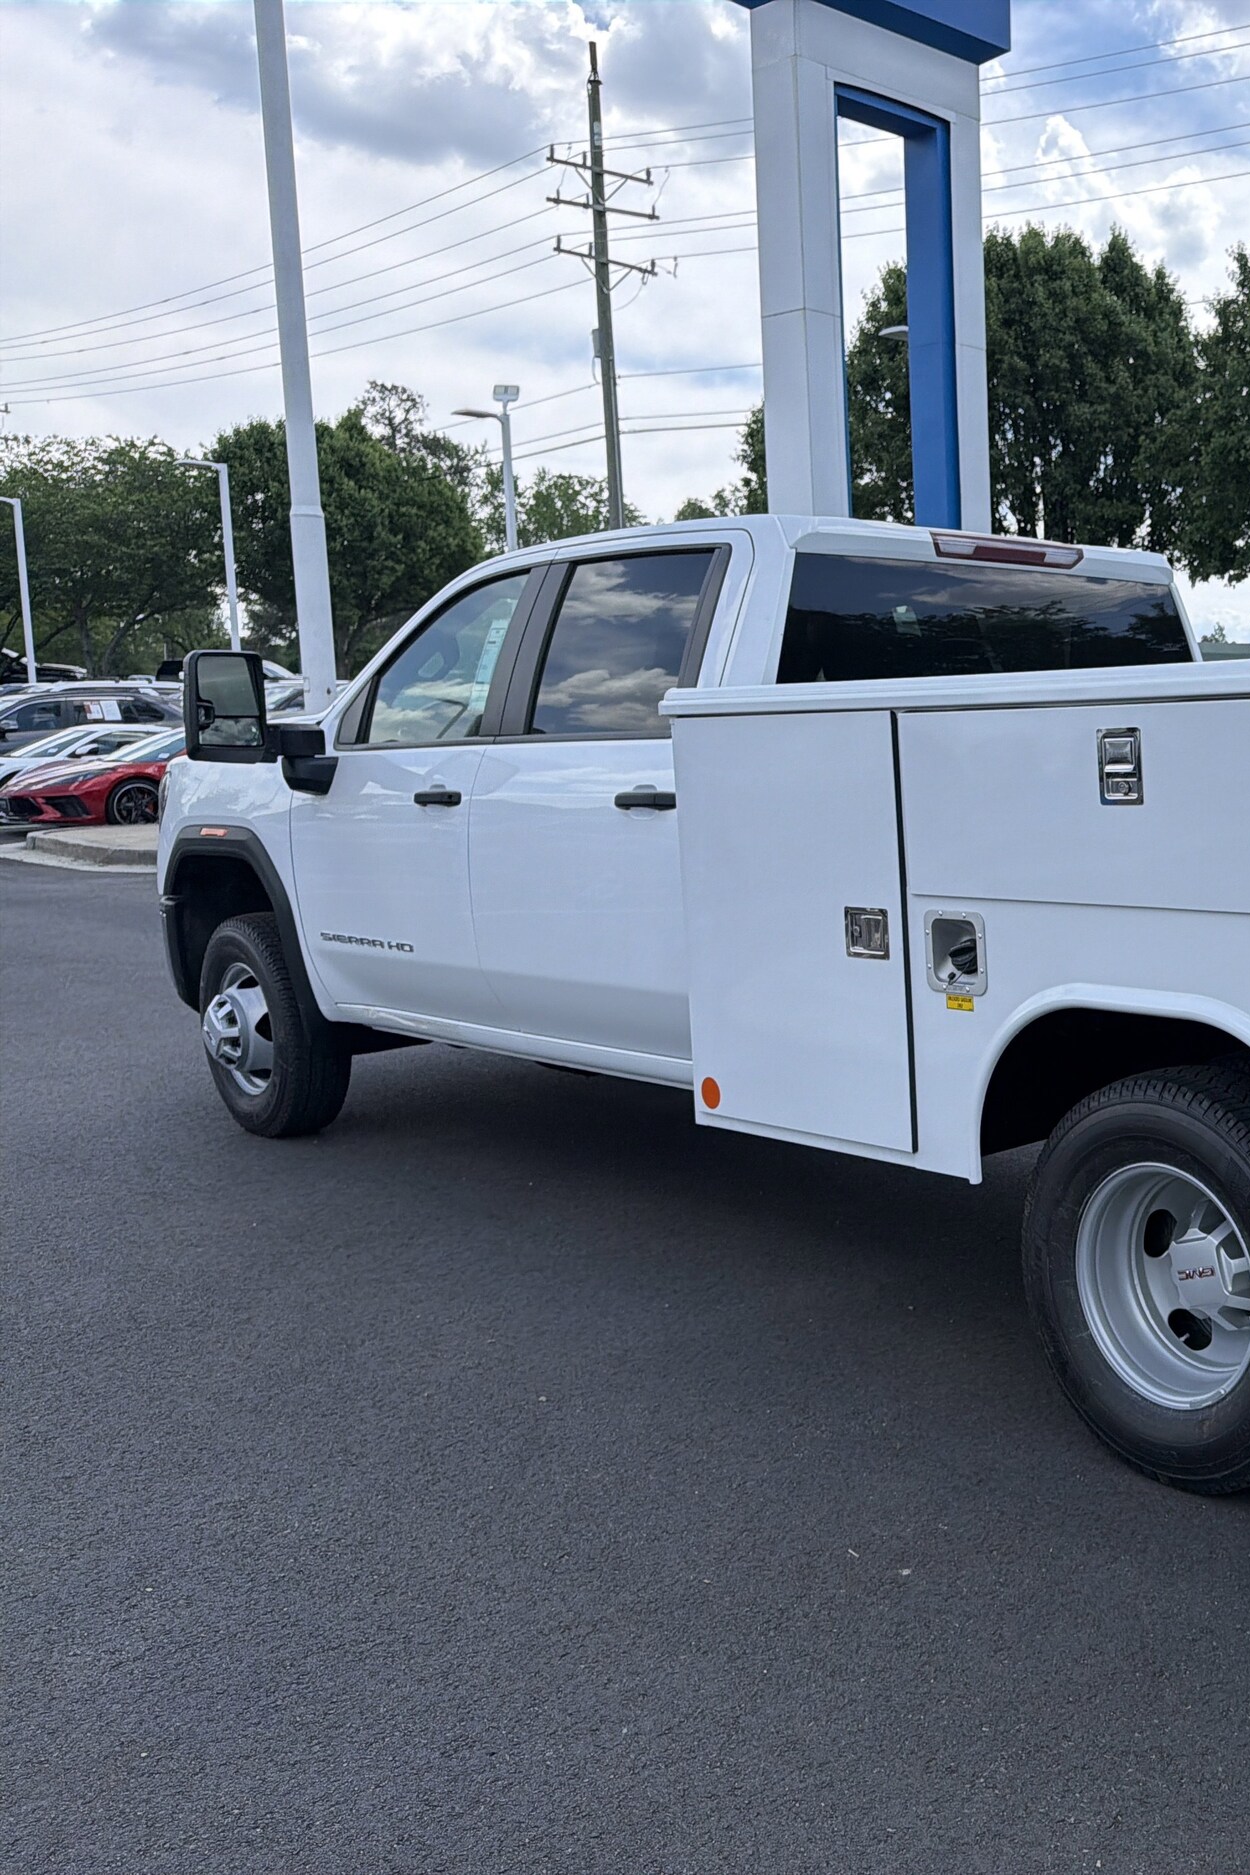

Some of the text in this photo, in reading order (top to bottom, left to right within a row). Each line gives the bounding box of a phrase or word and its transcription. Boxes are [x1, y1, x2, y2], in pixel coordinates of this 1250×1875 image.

[320, 932, 414, 953] SIERRA HD
[1177, 1265, 1217, 1282] GMC
